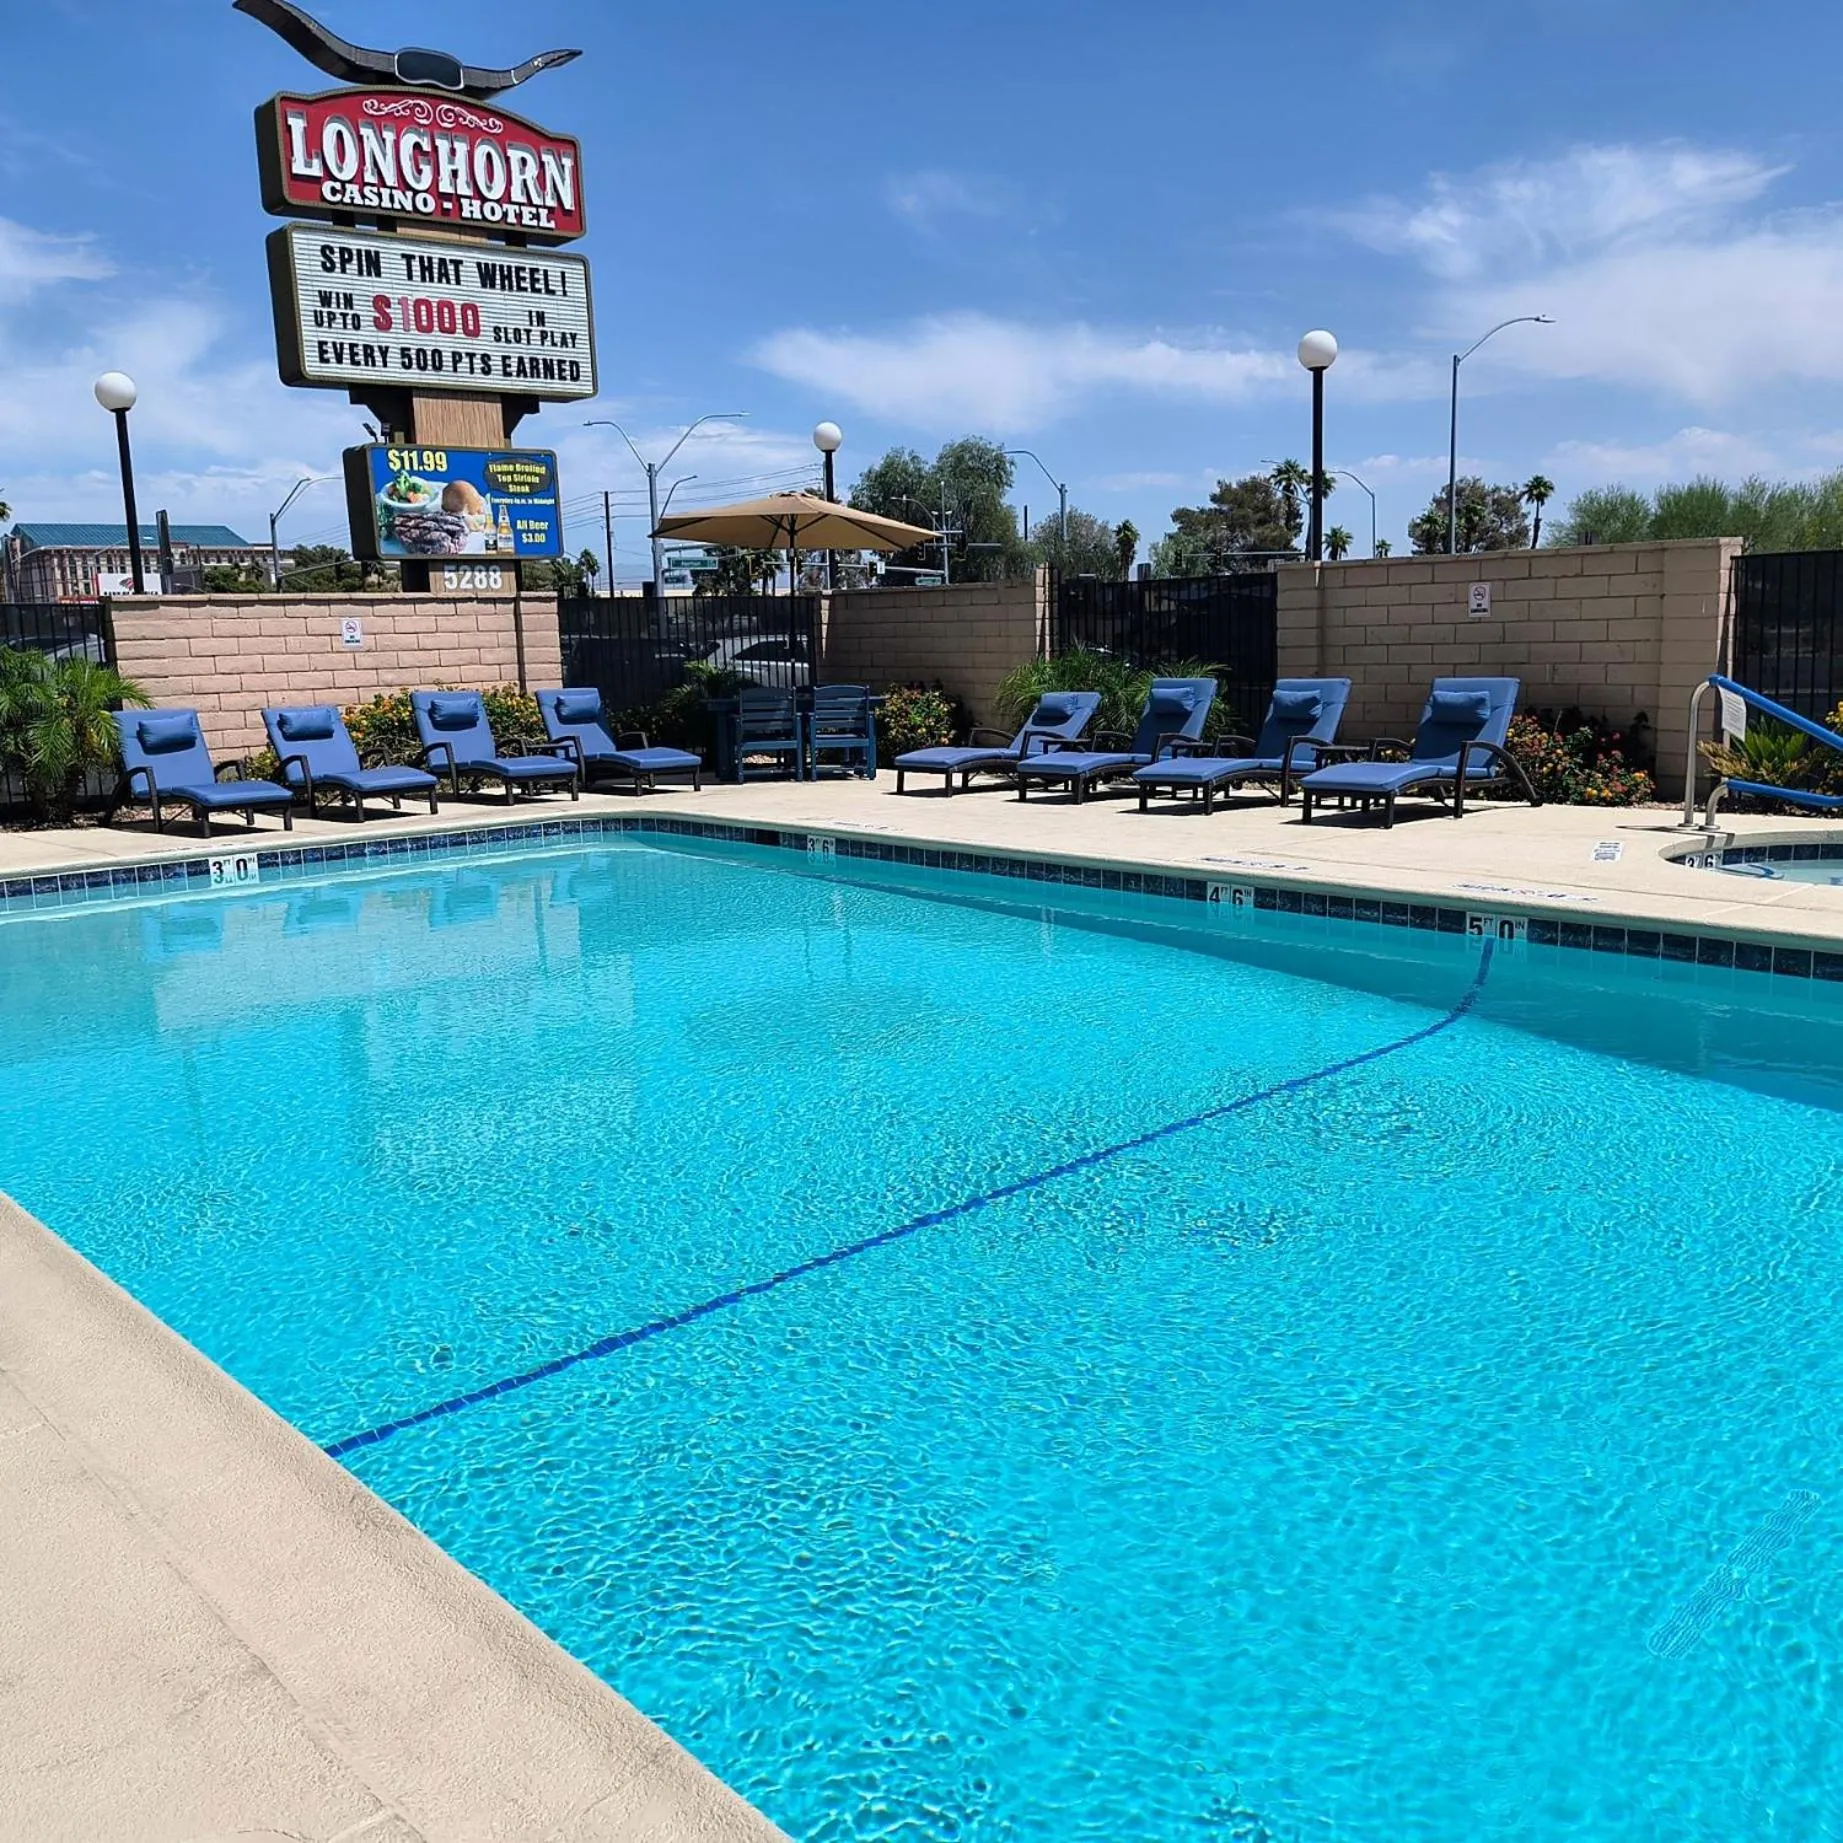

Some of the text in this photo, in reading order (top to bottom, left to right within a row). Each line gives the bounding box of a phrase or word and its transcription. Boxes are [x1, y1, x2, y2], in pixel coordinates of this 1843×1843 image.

[287, 111, 576, 211] LONGHORN
[321, 181, 436, 214] CASINO
[461, 199, 556, 229] HOTEL
[320, 244, 568, 297] SPIN THAT WHEEL!
[317, 290, 354, 310] WIN
[372, 293, 481, 338] $1000
[528, 310, 546, 327] IN
[493, 328, 578, 349] SLOT PLAY
[318, 340, 581, 382] EVERY 500 PTS EARNED
[388, 449, 448, 473] $11.99
[516, 519, 528, 530] All
[521, 532, 546, 544] $3.00
[444, 566, 502, 590] 5288
[212, 861, 224, 883] 3
[236, 859, 248, 880] 0
[1704, 854, 1714, 868] 6
[1208, 886, 1220, 903] 4
[1232, 888, 1244, 905] 6
[1469, 916, 1483, 936] 5
[1499, 919, 1515, 939] 0
